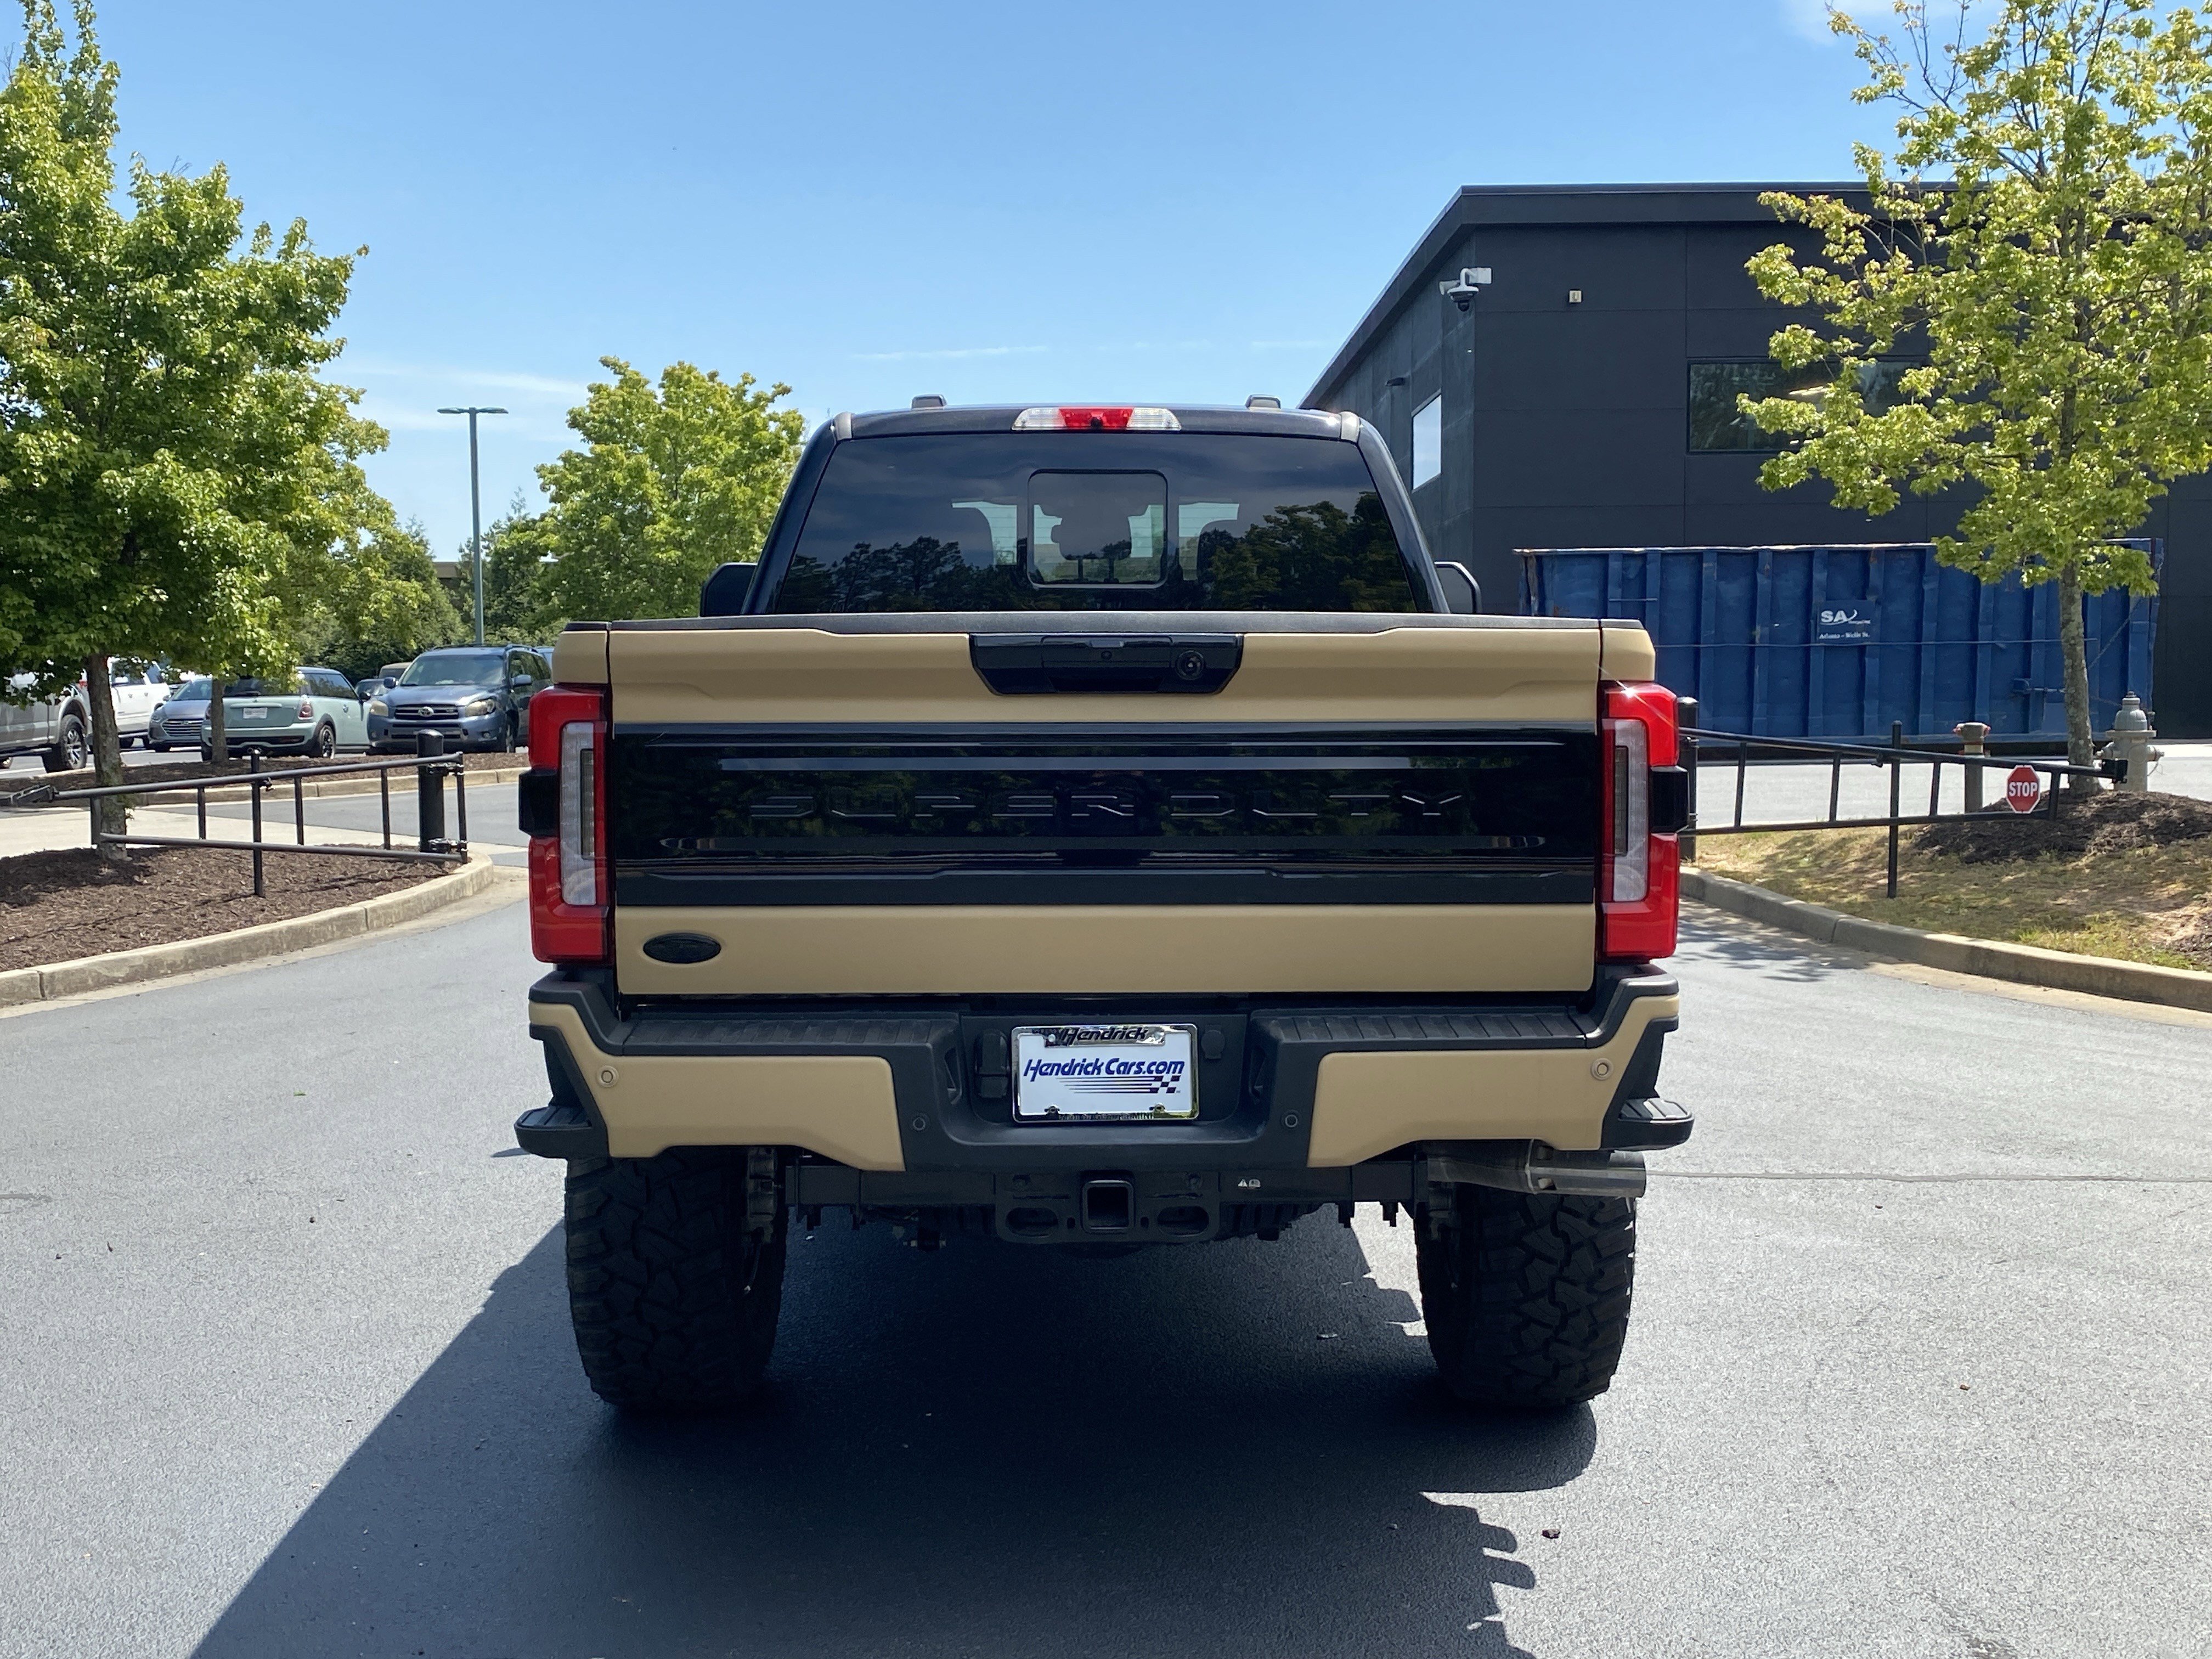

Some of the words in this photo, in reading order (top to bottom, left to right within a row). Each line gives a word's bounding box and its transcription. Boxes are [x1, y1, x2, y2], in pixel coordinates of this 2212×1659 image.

[1821, 610, 1847, 623] SA
[2008, 782, 2038, 797] STOP
[749, 789, 1135, 817] SUPER
[1169, 789, 1464, 817] DUTY
[1061, 1027, 1148, 1043] Hendrick
[1023, 1058, 1185, 1082] HendrickCars.com
